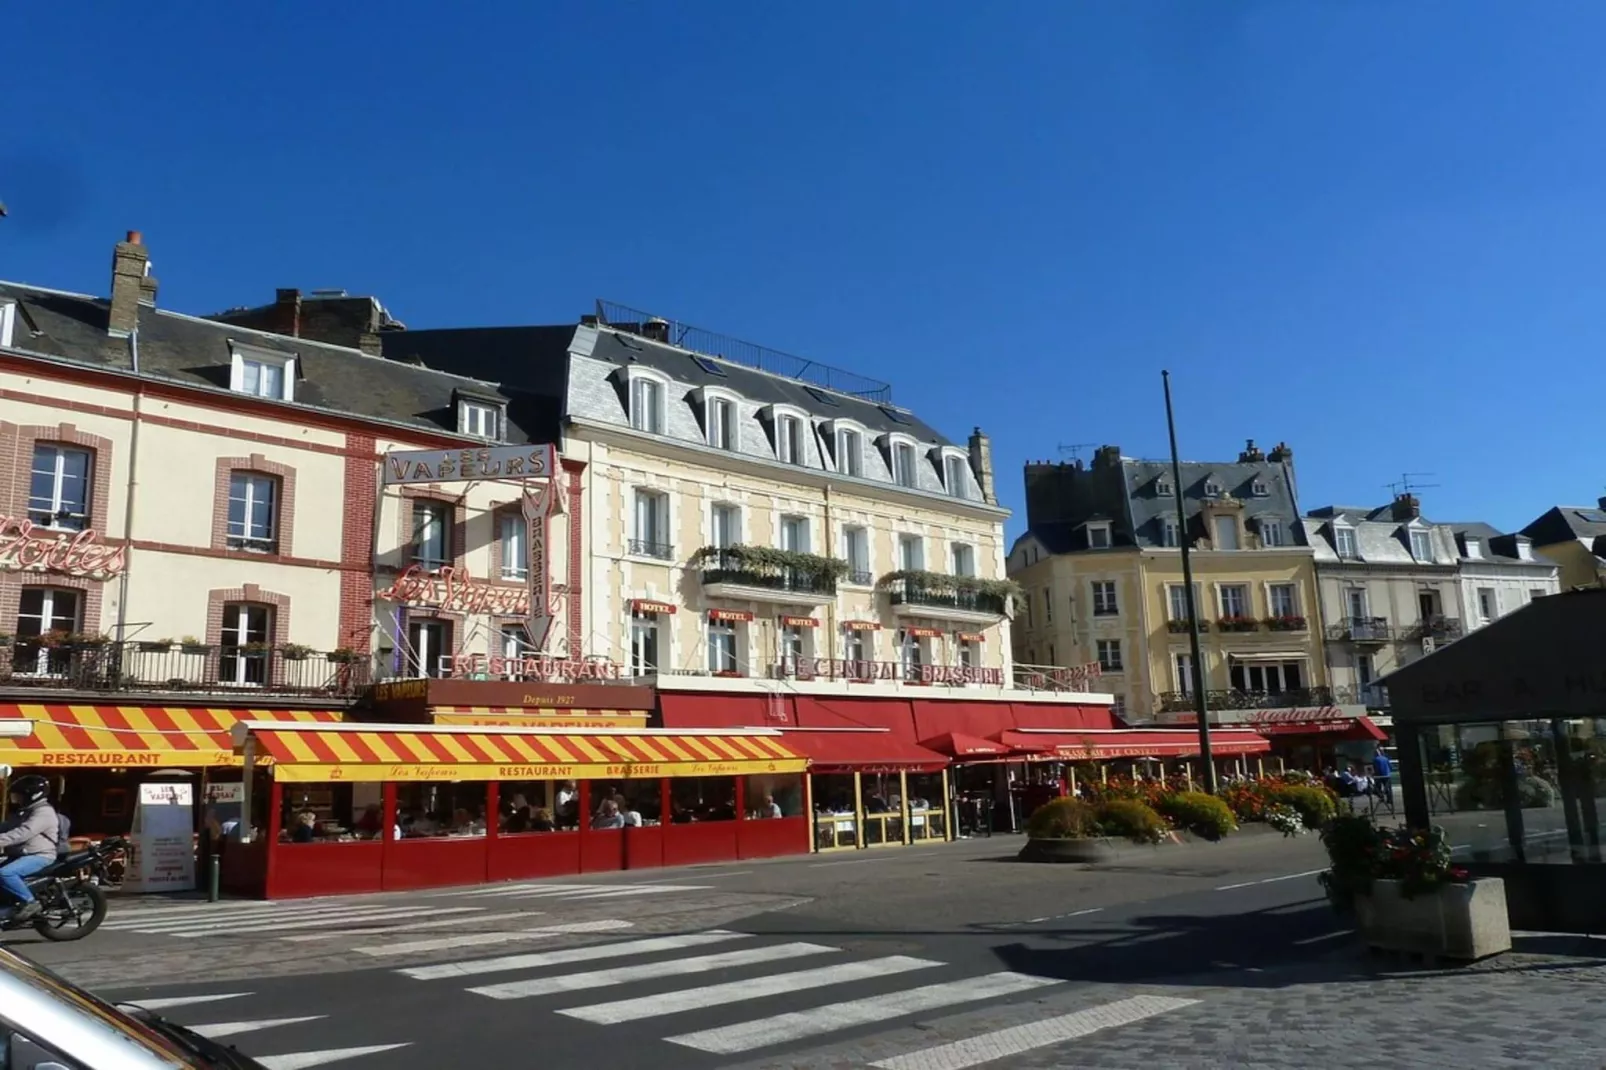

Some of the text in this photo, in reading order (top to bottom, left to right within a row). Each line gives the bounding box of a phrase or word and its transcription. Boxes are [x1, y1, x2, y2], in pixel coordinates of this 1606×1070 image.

[391, 451, 546, 480] VAPEURS
[532, 516, 543, 618] BRASSERIE
[640, 602, 671, 614] HOTEL
[718, 611, 747, 621] HOTEL
[453, 656, 624, 681] RESTAURANT
[42, 753, 161, 765] RESTAURANT
[500, 765, 573, 777] RESTAURANT
[606, 764, 660, 777] BRASSERIE
